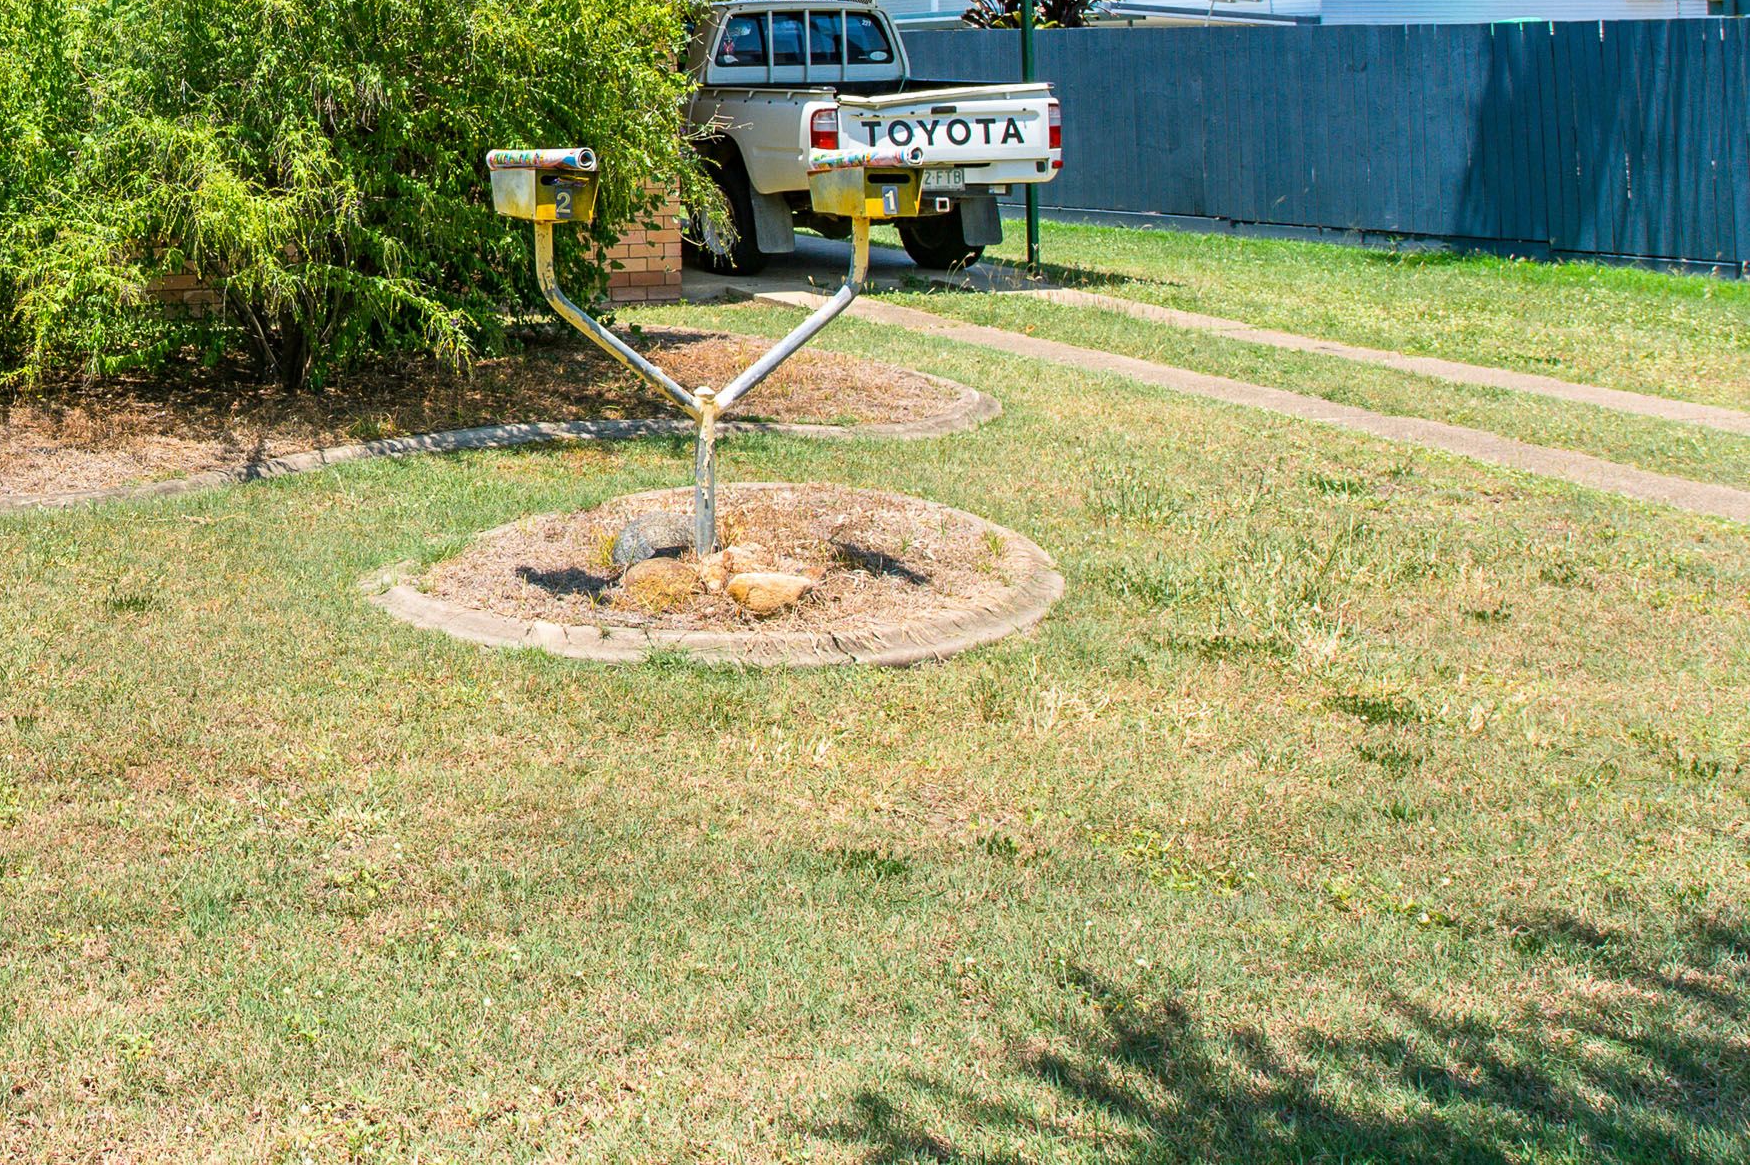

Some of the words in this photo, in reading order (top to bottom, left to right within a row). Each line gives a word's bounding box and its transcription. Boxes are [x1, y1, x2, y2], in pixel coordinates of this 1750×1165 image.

[861, 117, 1025, 147] TOYOTA
[556, 192, 570, 213] 2
[885, 190, 895, 211] 1
